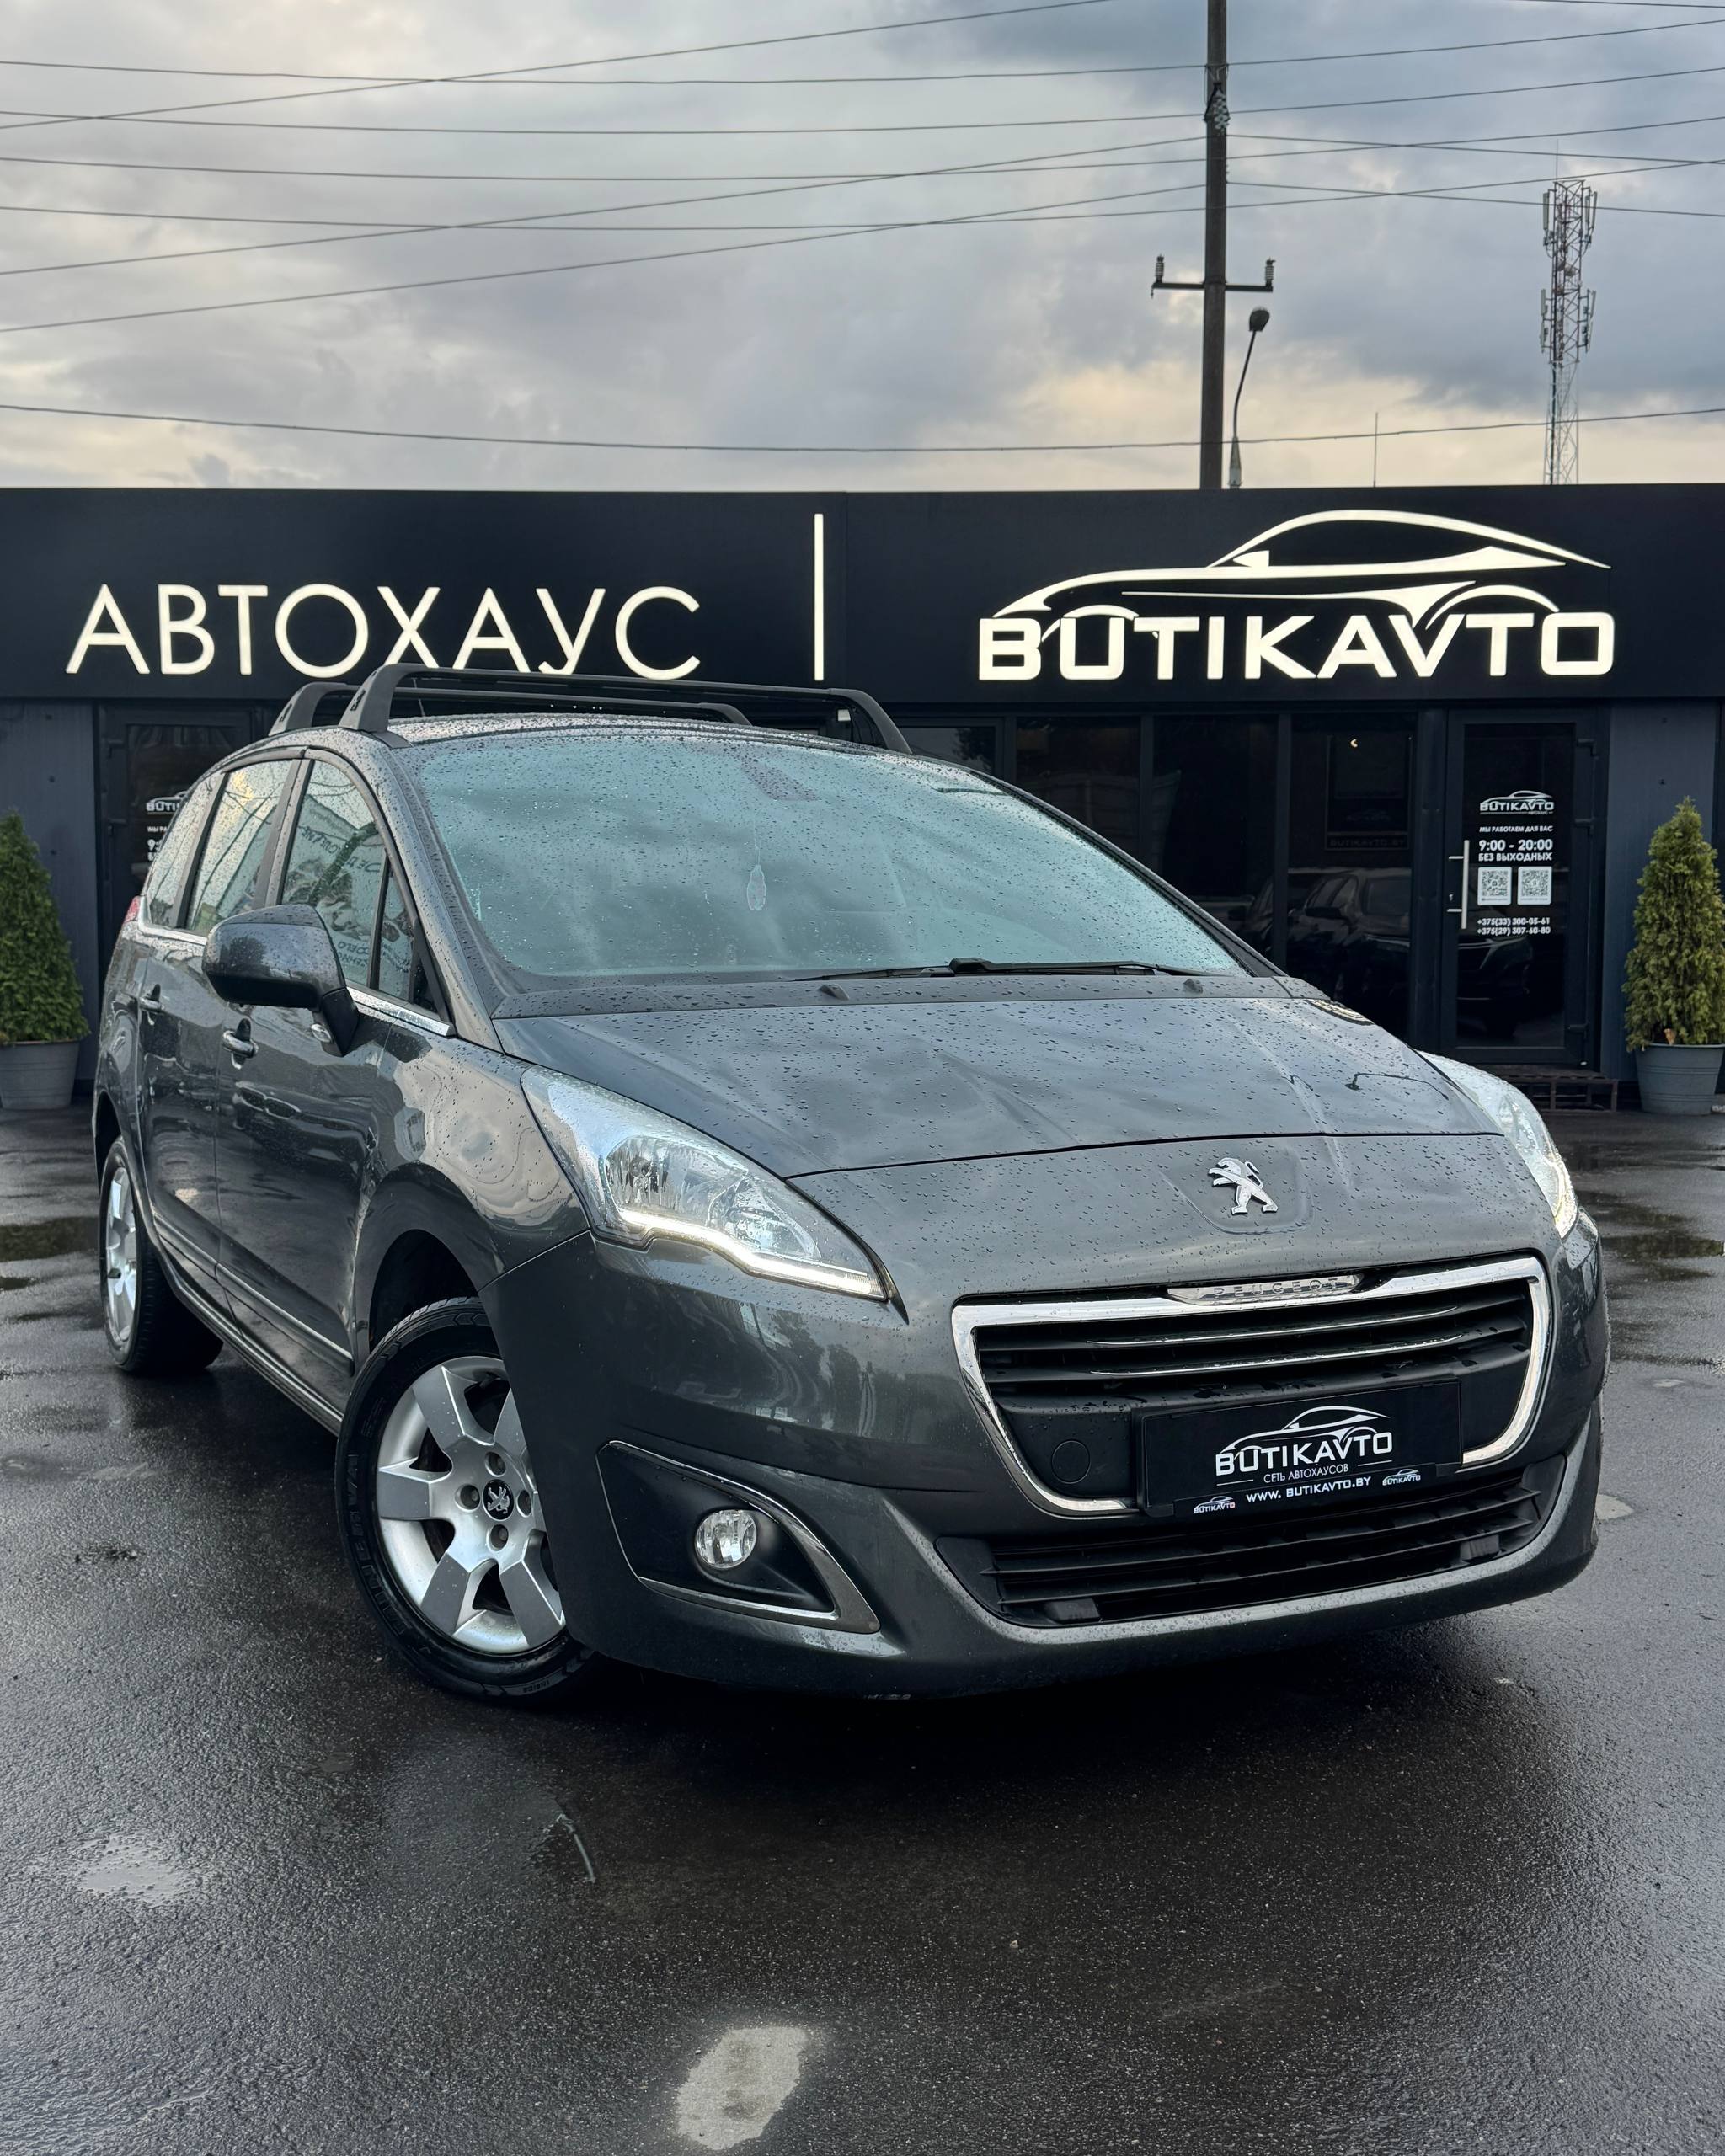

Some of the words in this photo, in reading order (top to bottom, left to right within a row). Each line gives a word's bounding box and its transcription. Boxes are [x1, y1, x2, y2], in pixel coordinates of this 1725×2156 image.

[66, 583, 701, 680] АВТОХАУС
[979, 611, 1615, 680] BUTIKAVTO
[1479, 801, 1554, 811] BUTIKAVTO
[1478, 840, 1506, 851] 9:00
[1518, 839, 1553, 851] 20:00
[1478, 852, 1494, 862] БЕЗ
[1496, 852, 1552, 862] ВЫХОДНЫХ
[1477, 918, 1511, 926] +375(33)
[1477, 927, 1511, 936] +375(29)
[1214, 1278, 1338, 1299] PEUGEOT
[1215, 1432, 1393, 1476] BUTIKAVTO
[1263, 1472, 1286, 1484] СЕТЬ
[1288, 1463, 1349, 1481] АВТОХАУСОВ
[1382, 1474, 1421, 1486] BUTIKAVTO
[1246, 1489, 1281, 1503] WWW.
[1286, 1476, 1371, 1497] BUTIKAVTO.BY
[1194, 1502, 1236, 1513] BUTIKAVTO
